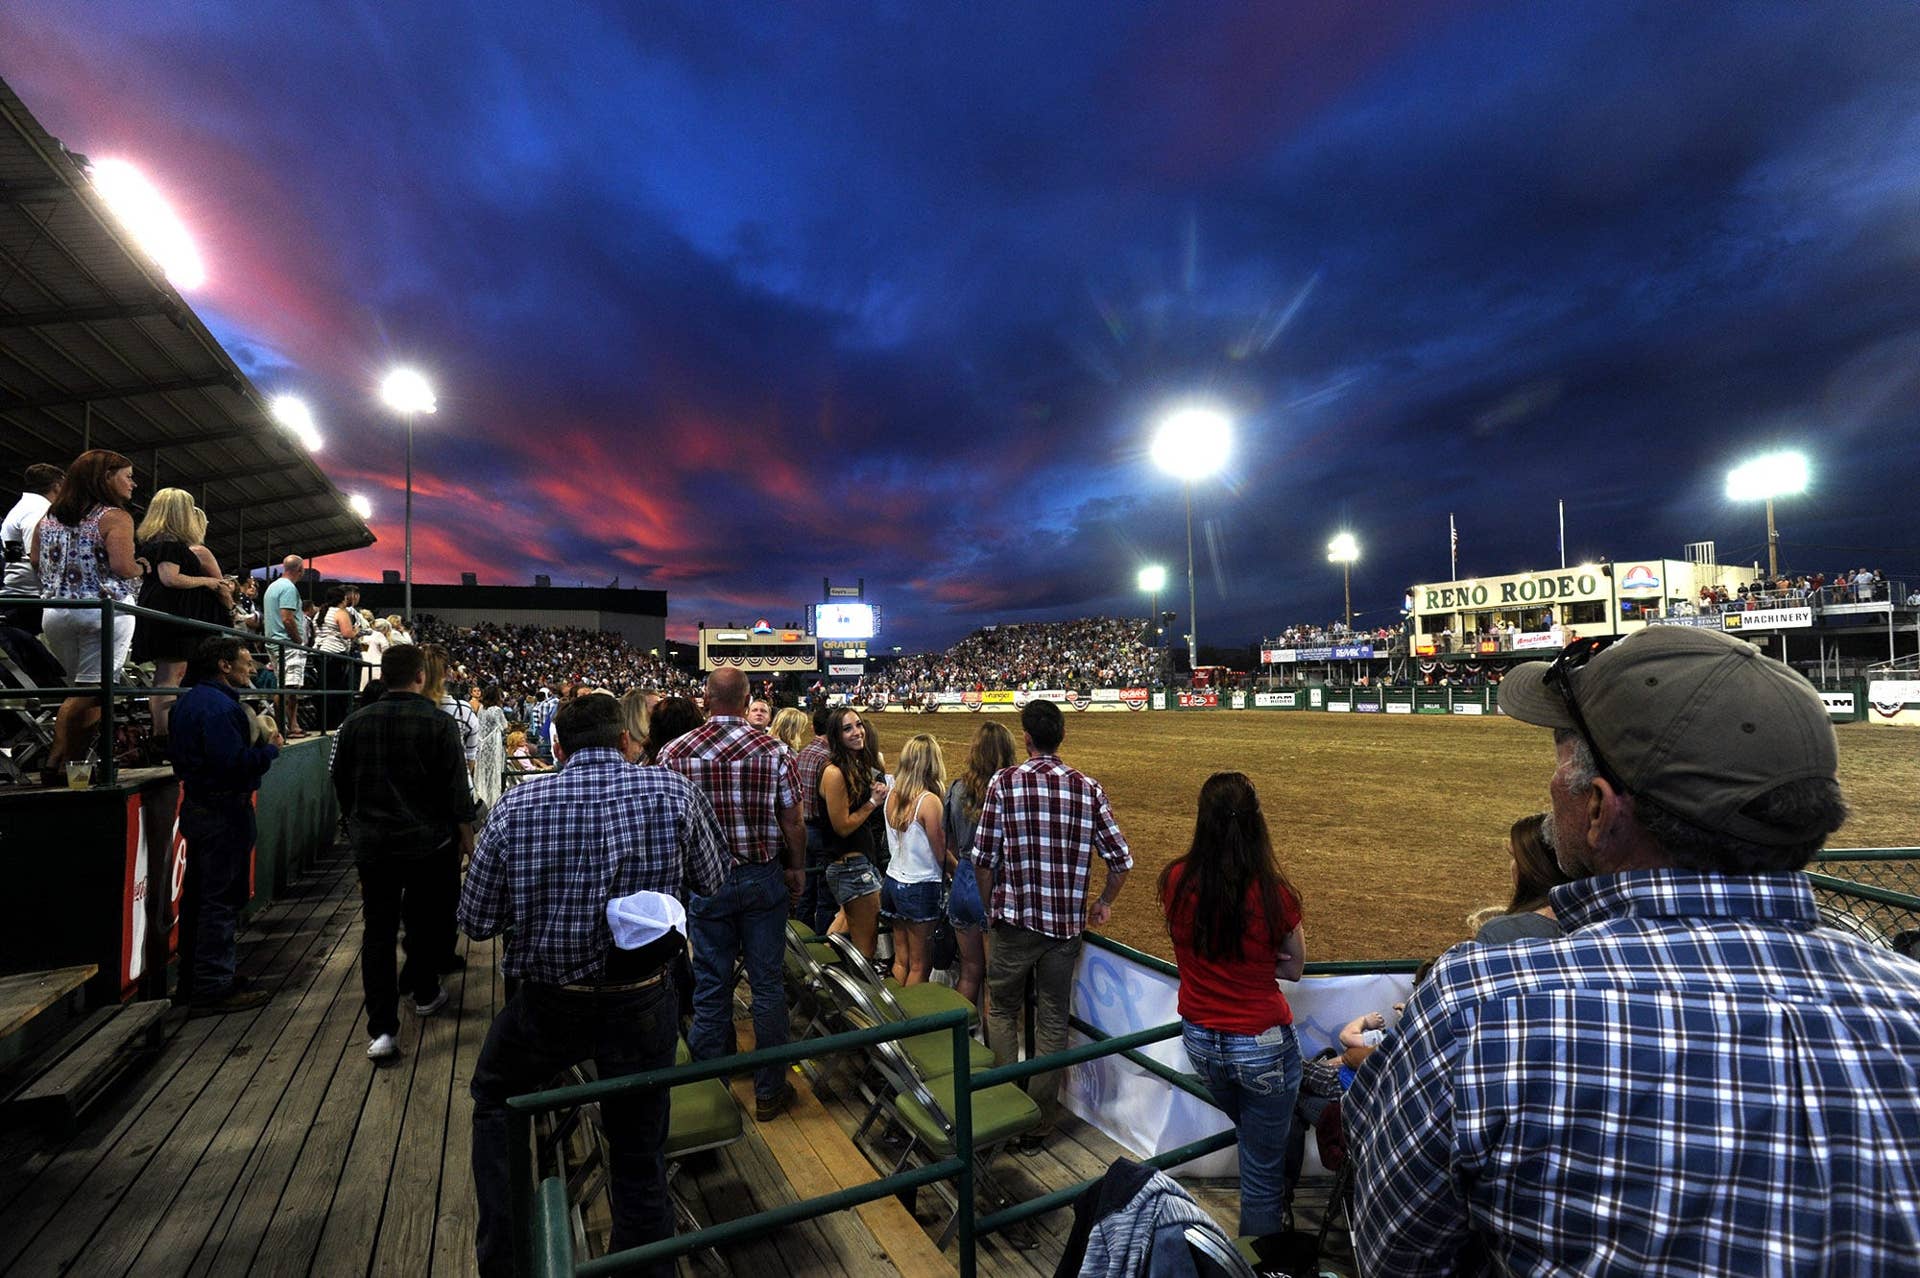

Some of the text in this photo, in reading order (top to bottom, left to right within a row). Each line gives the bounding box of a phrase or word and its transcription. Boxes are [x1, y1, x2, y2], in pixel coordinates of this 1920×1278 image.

[1426, 584, 1488, 609] RENO
[1501, 574, 1597, 603] RODEO
[1744, 612, 1809, 625] MACHINERY
[823, 640, 867, 649] GRANITE
